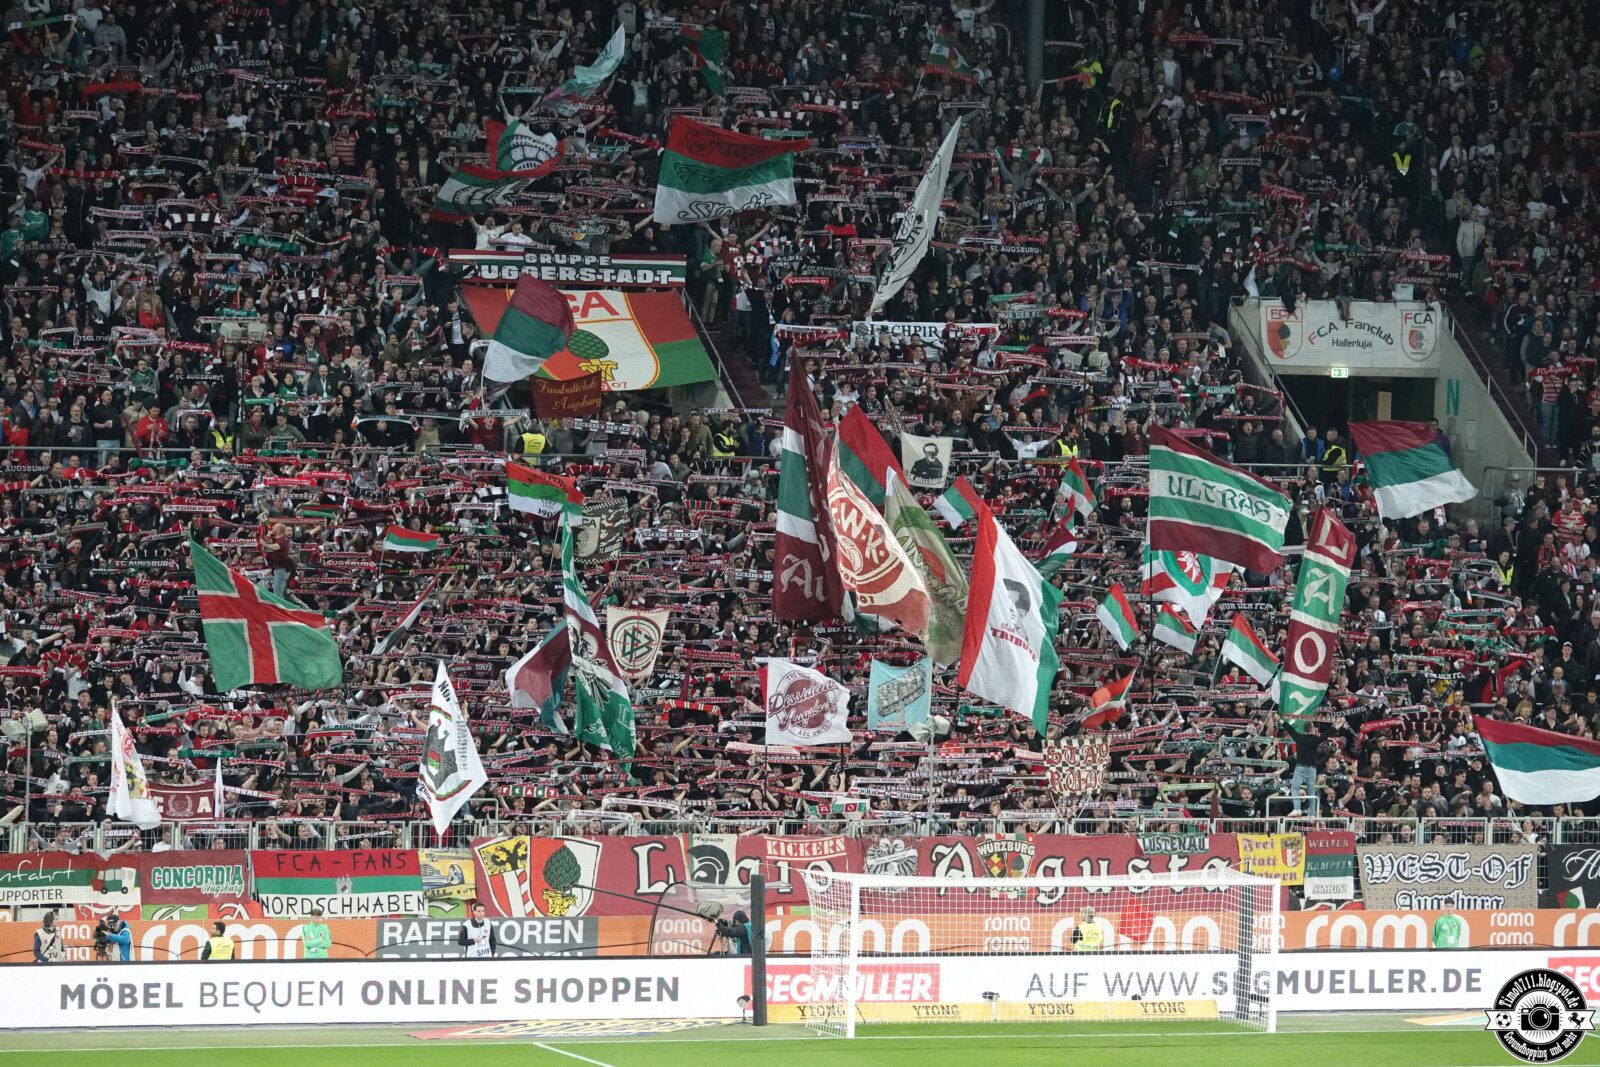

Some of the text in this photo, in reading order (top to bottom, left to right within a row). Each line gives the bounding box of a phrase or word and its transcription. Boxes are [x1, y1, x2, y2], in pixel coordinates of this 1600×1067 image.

[523, 252, 612, 266] GRUPPE
[1404, 312, 1434, 325] FCA
[1307, 317, 1395, 347] FCA Fanclub
[1331, 337, 1373, 350] Hallerluja
[1445, 378, 1460, 417] N
[1167, 473, 1271, 523] ULTRAS
[128, 559, 175, 568] AUGSBURG
[766, 837, 846, 856] KICKERS
[976, 838, 1037, 856] WÜRZBURG
[1141, 836, 1208, 854] LUSTENAU
[276, 852, 323, 872] FCA
[352, 852, 409, 870] FANS
[151, 865, 245, 889] CONCORDIA
[201, 881, 246, 898] Augsburg
[258, 893, 426, 916] NORDSCHWABEN
[1490, 912, 1535, 927] roma
[1489, 931, 1534, 946] roma
[60, 976, 680, 1013] MÖBEL BEQUEM ONLINE SHOPPEN
[765, 970, 935, 1004] SEGMÜLLER
[1025, 972, 1089, 999] AUF
[911, 1004, 961, 1017] YTONG
[1028, 1002, 1076, 1016] YTONG
[1140, 1000, 1187, 1014] YTONG
